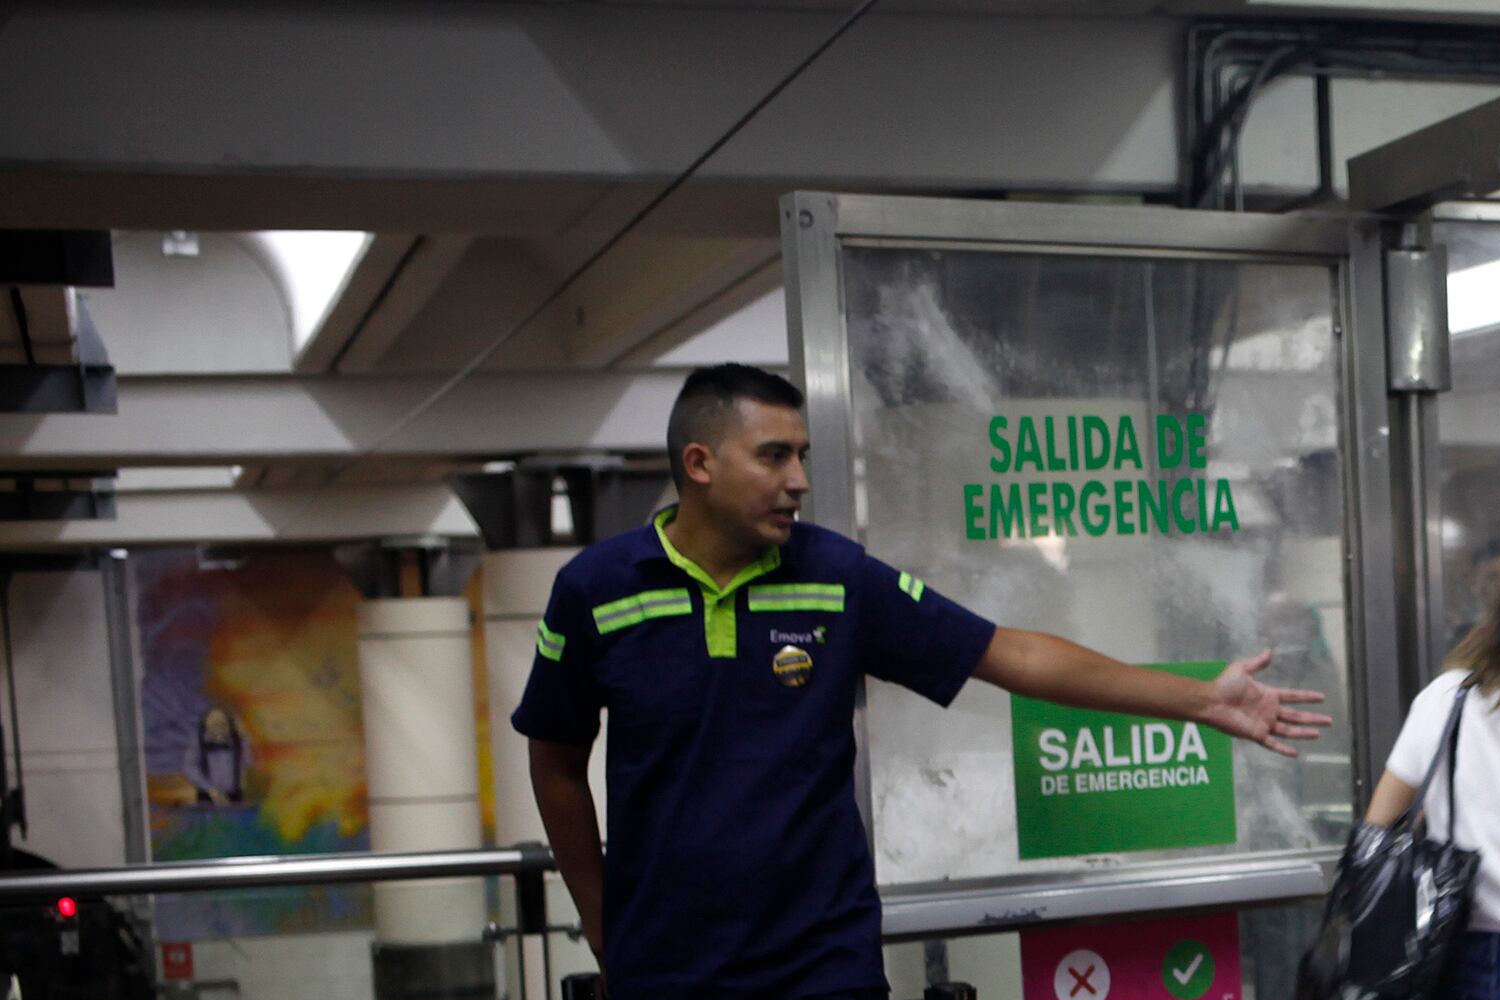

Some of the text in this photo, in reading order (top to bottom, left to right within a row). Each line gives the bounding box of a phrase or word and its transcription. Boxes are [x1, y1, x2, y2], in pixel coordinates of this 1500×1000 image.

[989, 415, 1207, 472] SALIDA DE
[964, 478, 1239, 540] EMERGENCIA
[770, 629, 813, 643] Emova
[1038, 721, 1208, 772] SALIDA
[1040, 765, 1210, 796] DE EMERGENCIA
